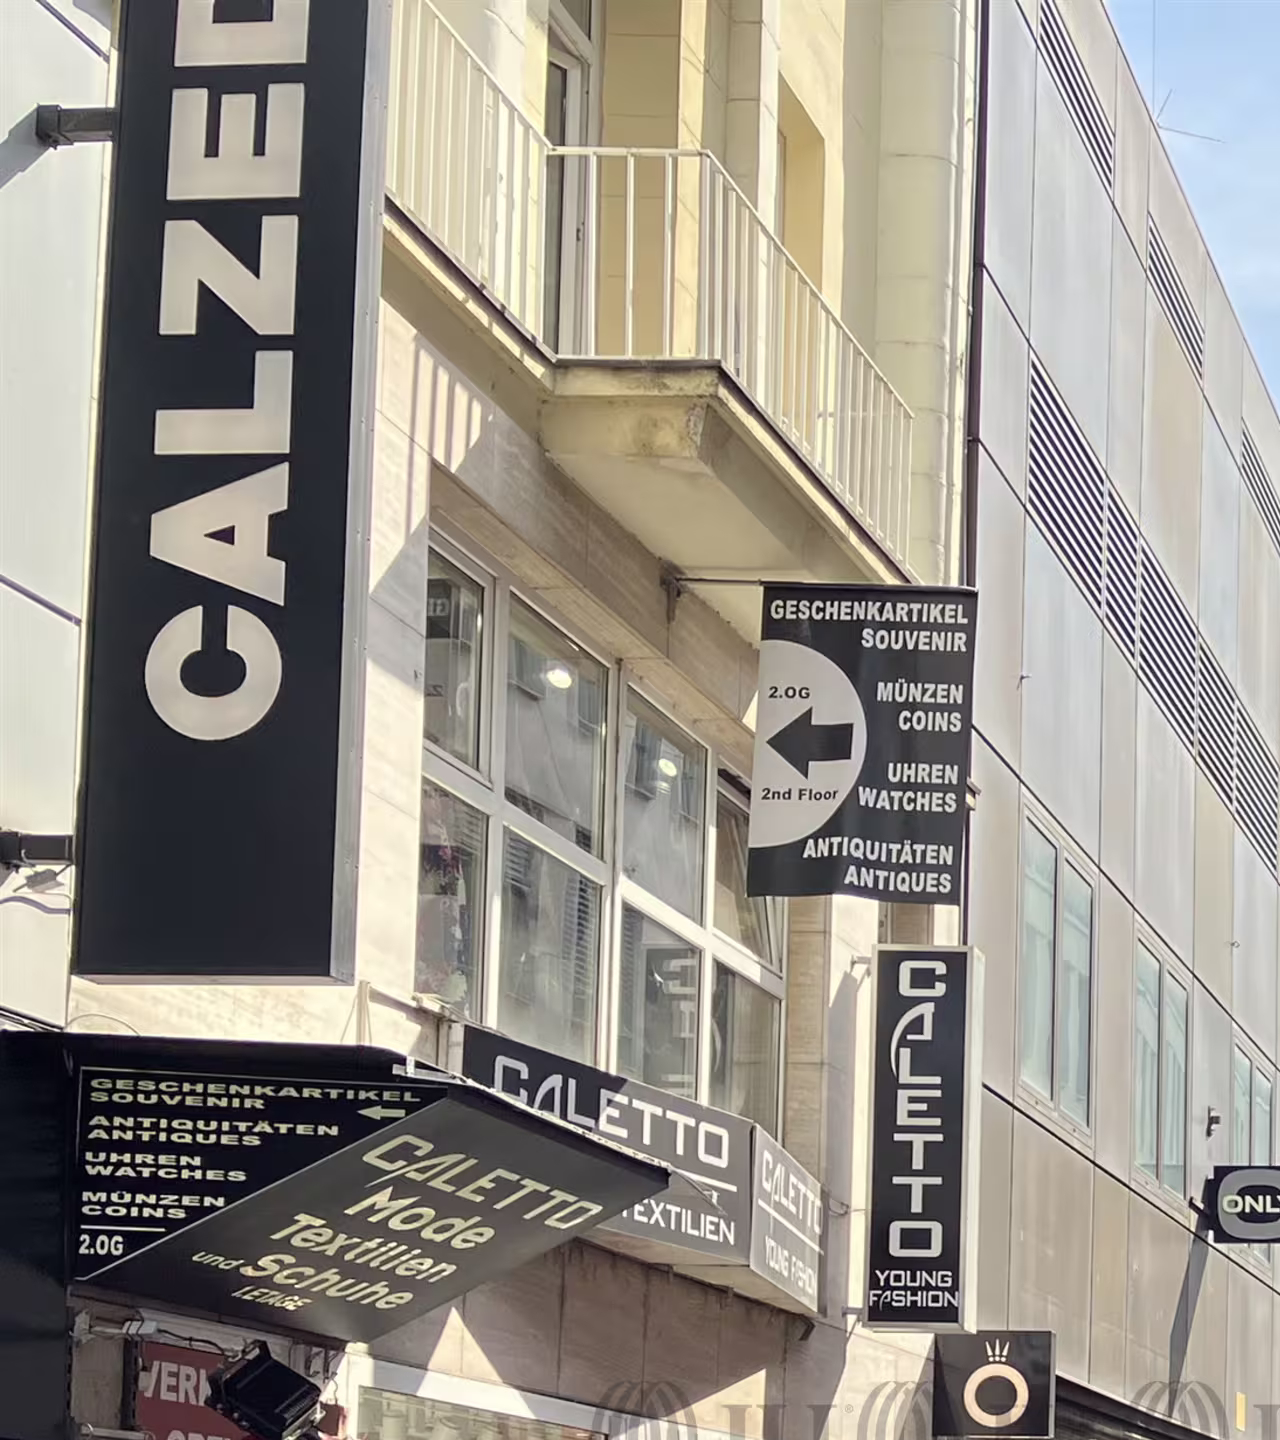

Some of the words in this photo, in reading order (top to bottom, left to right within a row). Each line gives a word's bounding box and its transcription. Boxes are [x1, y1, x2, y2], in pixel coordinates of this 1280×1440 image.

[769, 600, 969, 624] GESCHENKARTIKEL
[860, 628, 968, 652] SOUVENIR
[876, 678, 964, 704] MÜNZEN
[898, 710, 962, 733] COINS
[887, 762, 959, 785] UHREN
[761, 787, 792, 801] 2nd
[797, 787, 839, 801] Floor
[858, 785, 958, 813] WATCHES
[802, 836, 954, 866] ANTIQUITÄTEN
[844, 865, 953, 894] ANTIQUES
[90, 1079, 422, 1103] GESCHENKARTIKEL
[90, 1092, 267, 1110] SOUVENIR
[493, 1054, 730, 1169] CALETTO
[889, 960, 947, 1259] CALETTO
[87, 1129, 262, 1147] ANTIQUES
[88, 1116, 340, 1137] ANTIQUITÄTEN
[84, 1152, 202, 1167] UHREN
[84, 1165, 248, 1182] WATCHES
[361, 1134, 604, 1230] CALETTO
[81, 1190, 226, 1208] MÜNZEN
[81, 1205, 188, 1220] COINS
[343, 1186, 496, 1250] Mode
[269, 1213, 458, 1283] Textilien
[191, 1250, 246, 1272] und
[238, 1253, 415, 1310] Schuhe
[874, 1270, 953, 1288] YOUNG
[869, 1290, 960, 1309] FASHION
